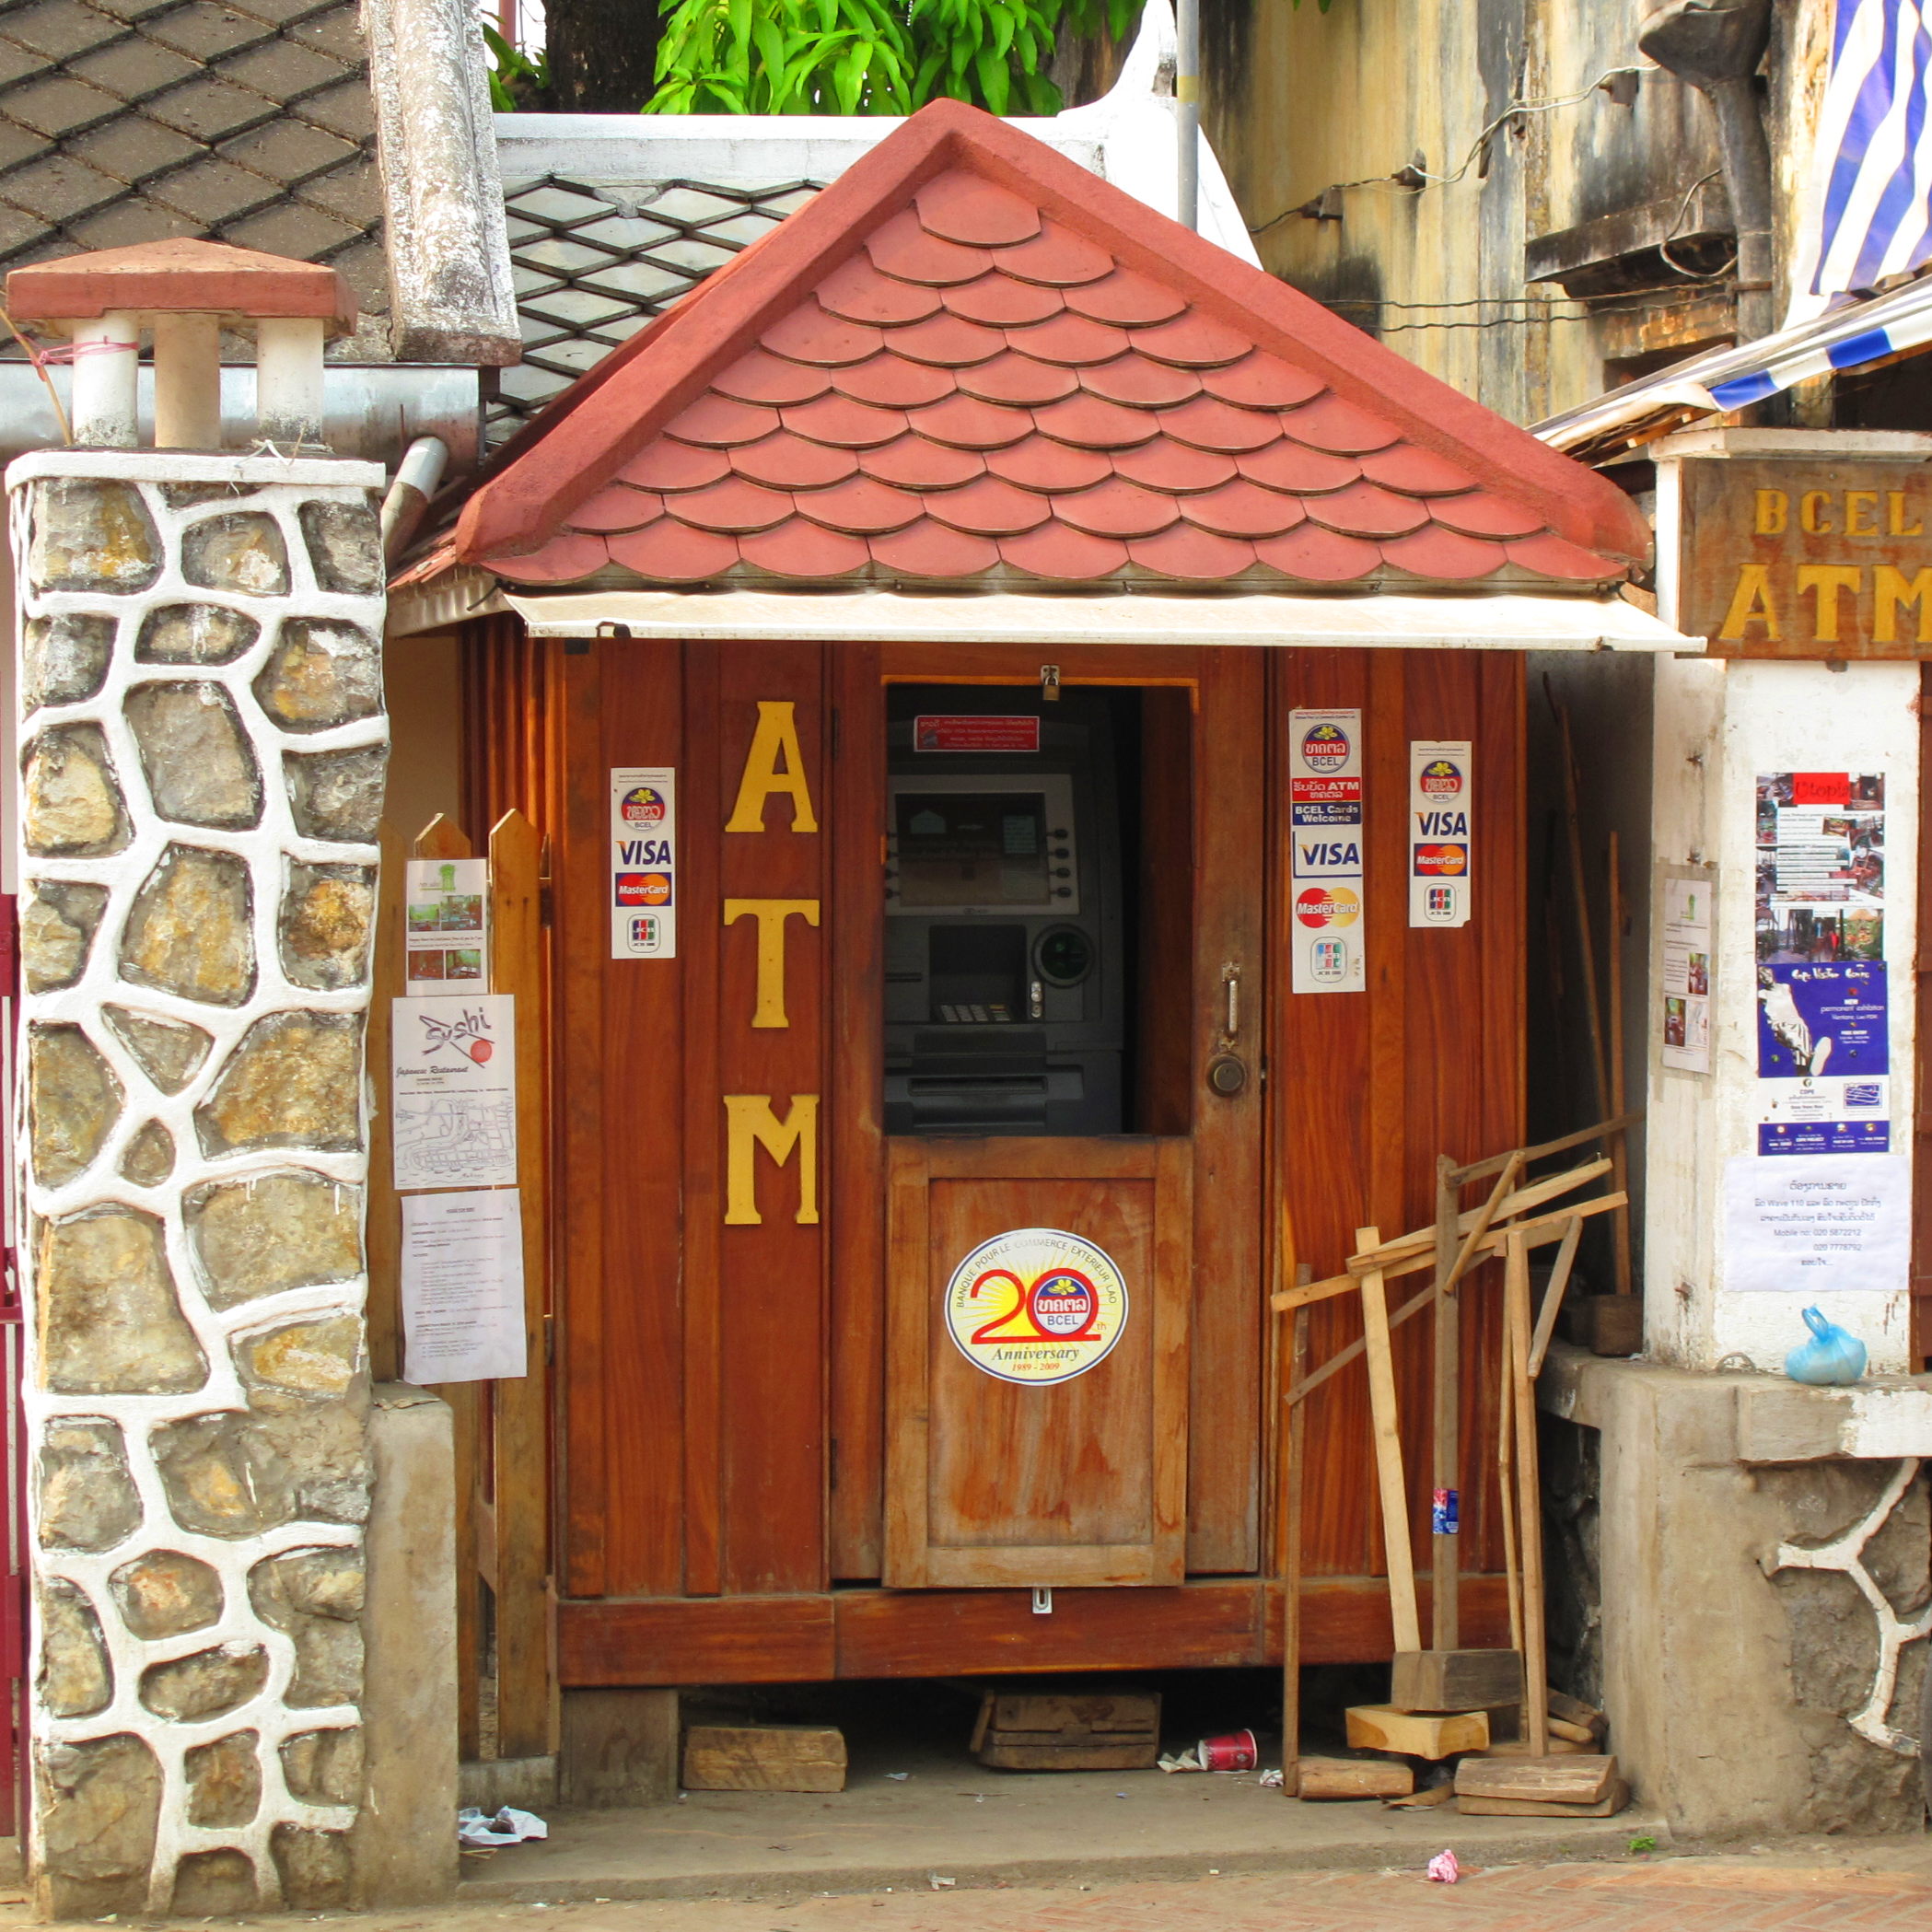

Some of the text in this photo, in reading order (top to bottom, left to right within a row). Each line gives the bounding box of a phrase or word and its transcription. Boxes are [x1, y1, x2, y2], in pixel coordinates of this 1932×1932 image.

[1754, 489, 1923, 536] BCEL
[1718, 563, 1932, 642] ATM
[1312, 757, 1340, 766] BCEL
[1328, 782, 1359, 791] ATM
[1796, 781, 1849, 801] Utopia
[1295, 805, 1358, 815] BCEL Cards
[1302, 814, 1352, 823] Welcome
[1414, 812, 1468, 836] VISA
[615, 840, 672, 865] VISA
[1298, 843, 1360, 866] VISA
[1417, 855, 1464, 865] MasterCard
[619, 885, 669, 895] MasterCard
[1297, 902, 1358, 914] MasterCard
[724, 701, 820, 1225] ATM
[396, 1065, 470, 1077] Japanese Restaurant
[957, 1270, 977, 1308] BANQUE
[976, 1248, 1000, 1269] POUR
[1000, 1243, 1012, 1253] LE
[1071, 1246, 1110, 1282] EXTERIEUR
[1106, 1285, 1117, 1304] LAO
[1047, 1315, 1079, 1326] BCEL
[992, 1347, 1080, 1362] Anniversary
[1012, 1363, 1032, 1371] 1989
[1040, 1363, 1060, 1371] 2009
